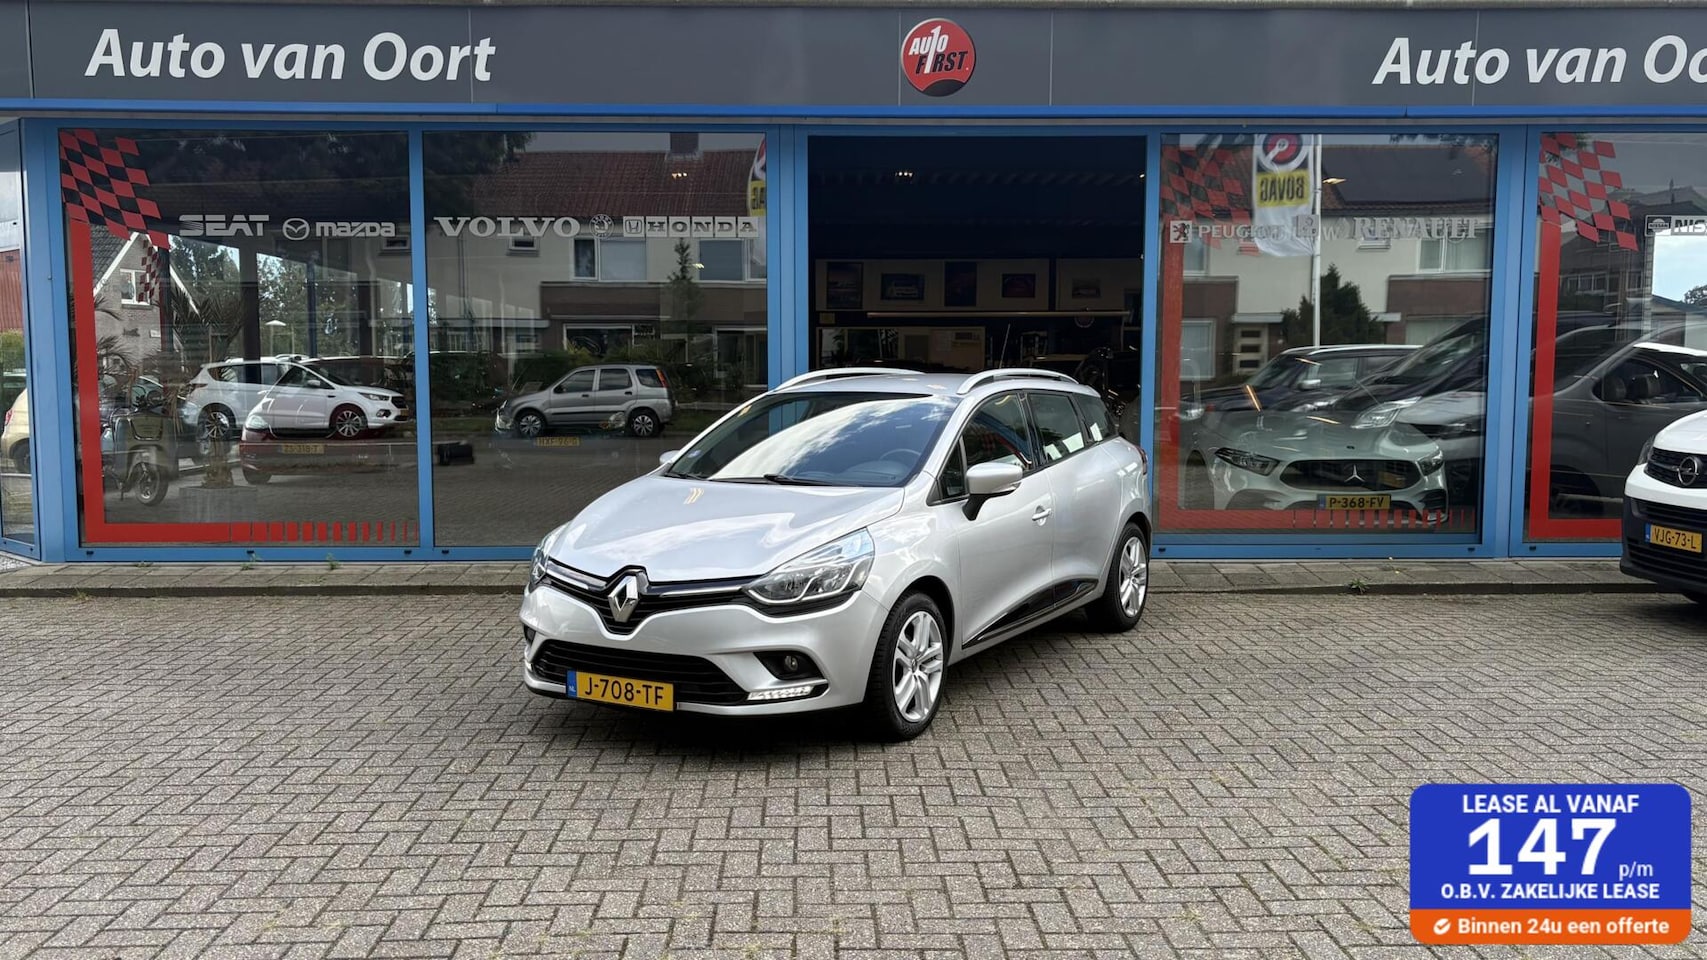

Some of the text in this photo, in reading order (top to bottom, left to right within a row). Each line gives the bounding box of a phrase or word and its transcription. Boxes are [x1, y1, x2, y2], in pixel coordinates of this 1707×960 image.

[908, 28, 949, 56] AUTO
[84, 28, 496, 82] Auto van Oort
[915, 50, 968, 74] FIRST
[1371, 37, 1510, 85] Auto
[1526, 47, 1627, 84] van
[179, 214, 270, 237] SEAT
[434, 216, 581, 237] VOLVO
[647, 219, 759, 234] HONDA
[1353, 217, 1479, 239] RENAULT
[1329, 497, 1384, 508] P-368-FV
[1654, 527, 1697, 550] VJG-73-L
[585, 677, 664, 705] J-708-TF
